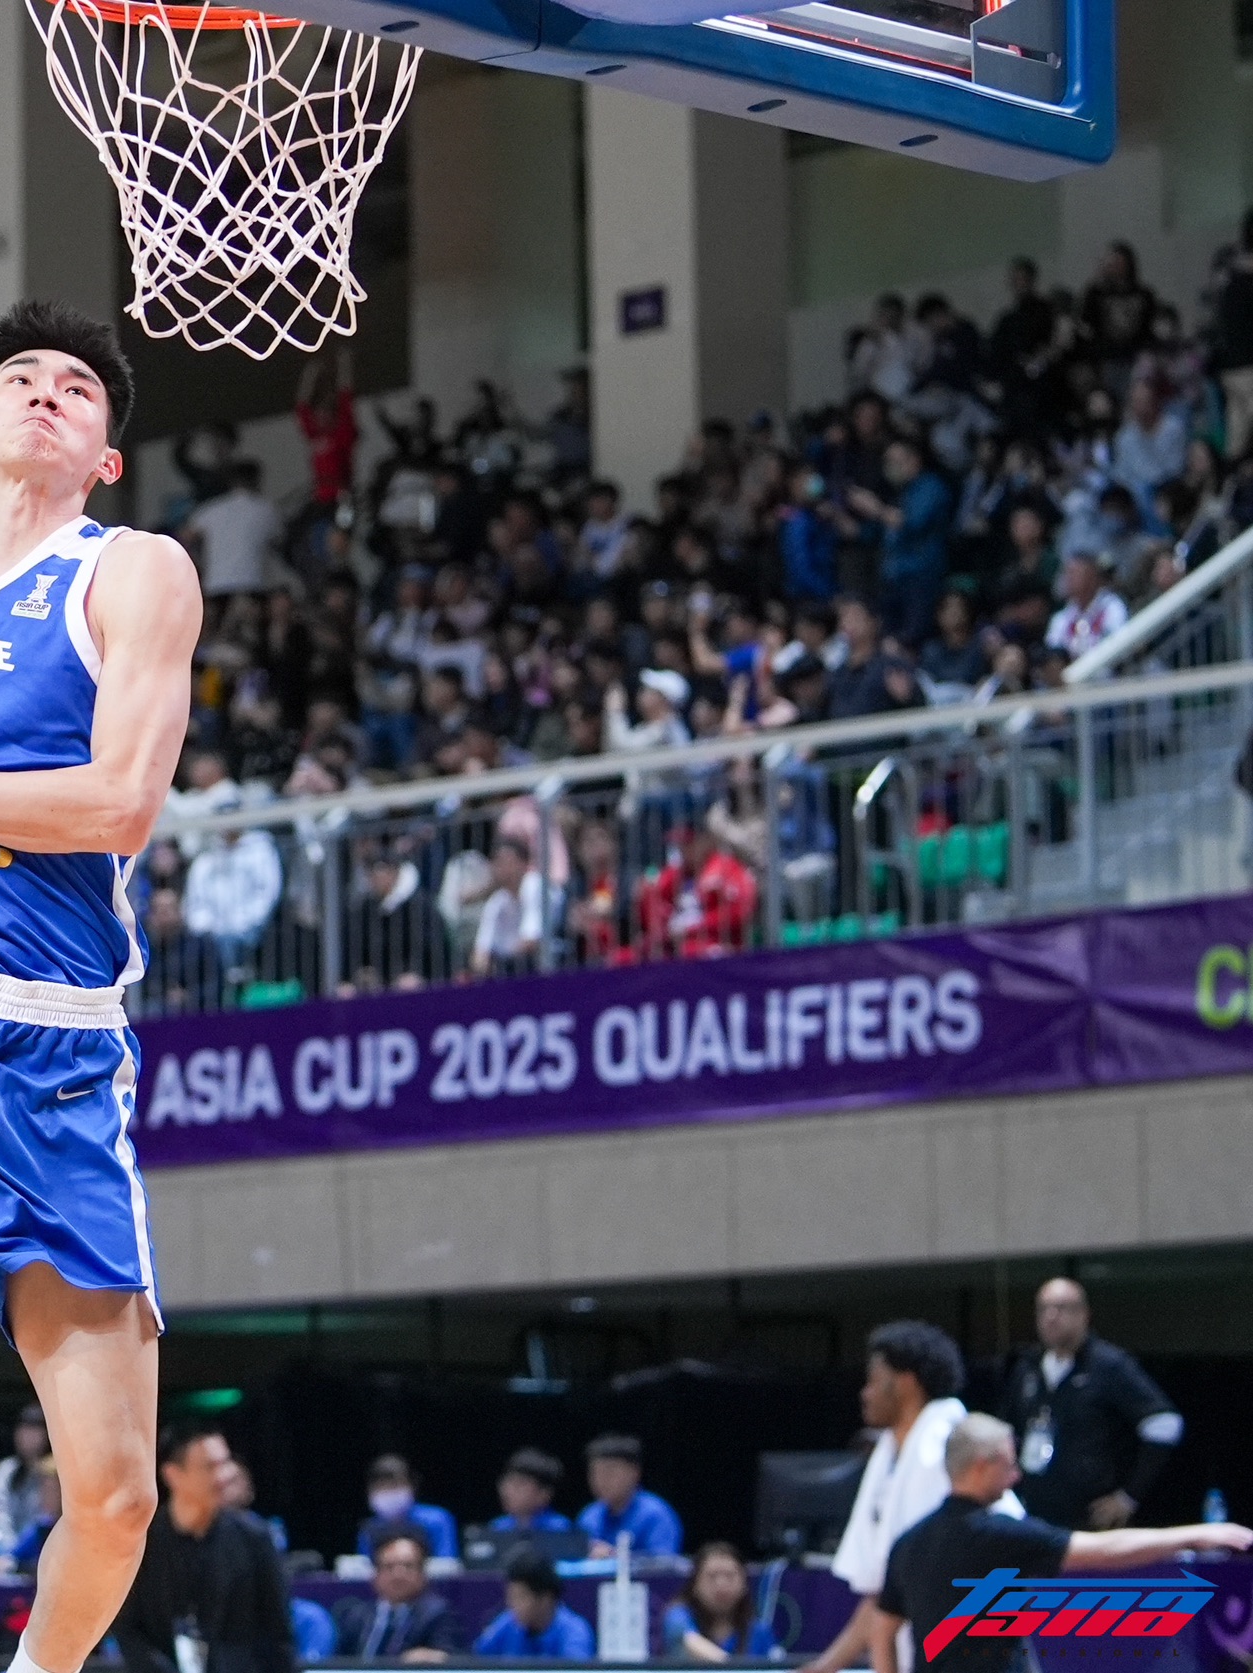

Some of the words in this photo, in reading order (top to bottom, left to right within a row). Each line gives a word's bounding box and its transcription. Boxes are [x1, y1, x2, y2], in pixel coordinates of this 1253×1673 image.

[147, 1043, 284, 1130] ASIA
[294, 1028, 419, 1113] CUP
[431, 1012, 578, 1100] 2025
[593, 970, 984, 1087] QUALIFIERS
